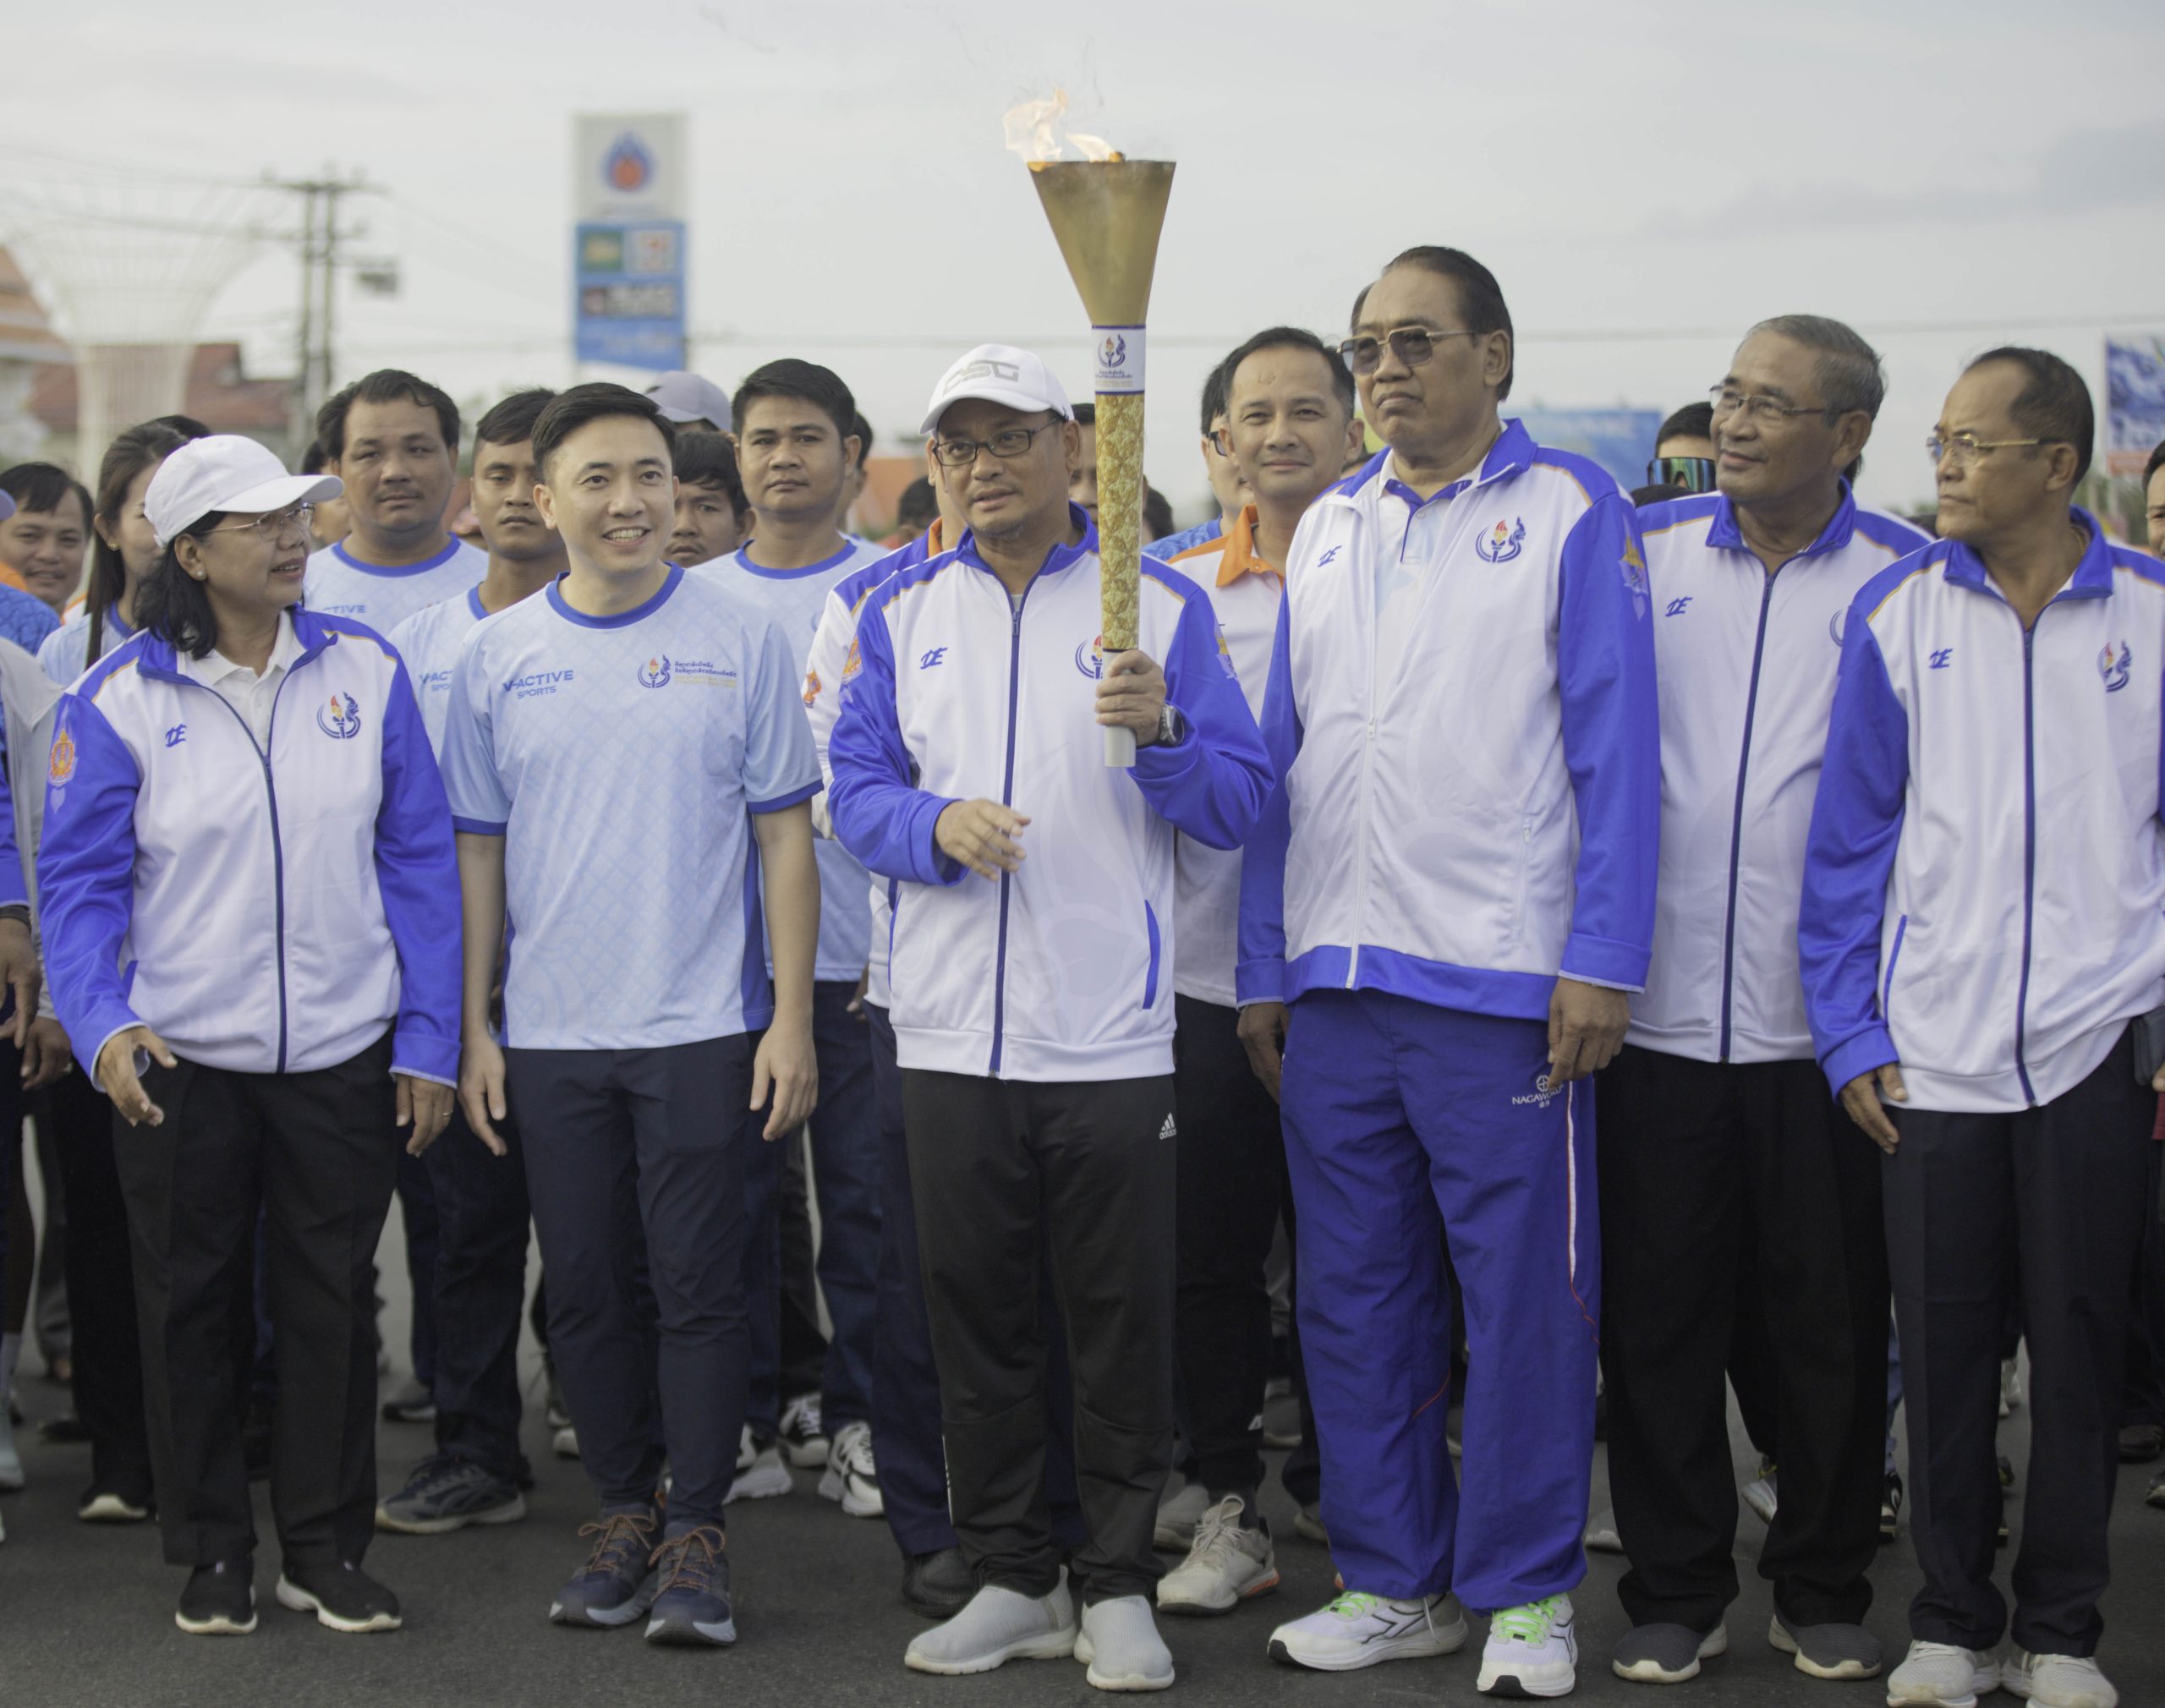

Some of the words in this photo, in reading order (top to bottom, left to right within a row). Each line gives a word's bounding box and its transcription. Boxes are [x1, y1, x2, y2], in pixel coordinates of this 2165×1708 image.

[323, 605, 365, 614] TIVE
[502, 670, 573, 692] V-ACTIVE
[518, 686, 556, 699] SPORTS
